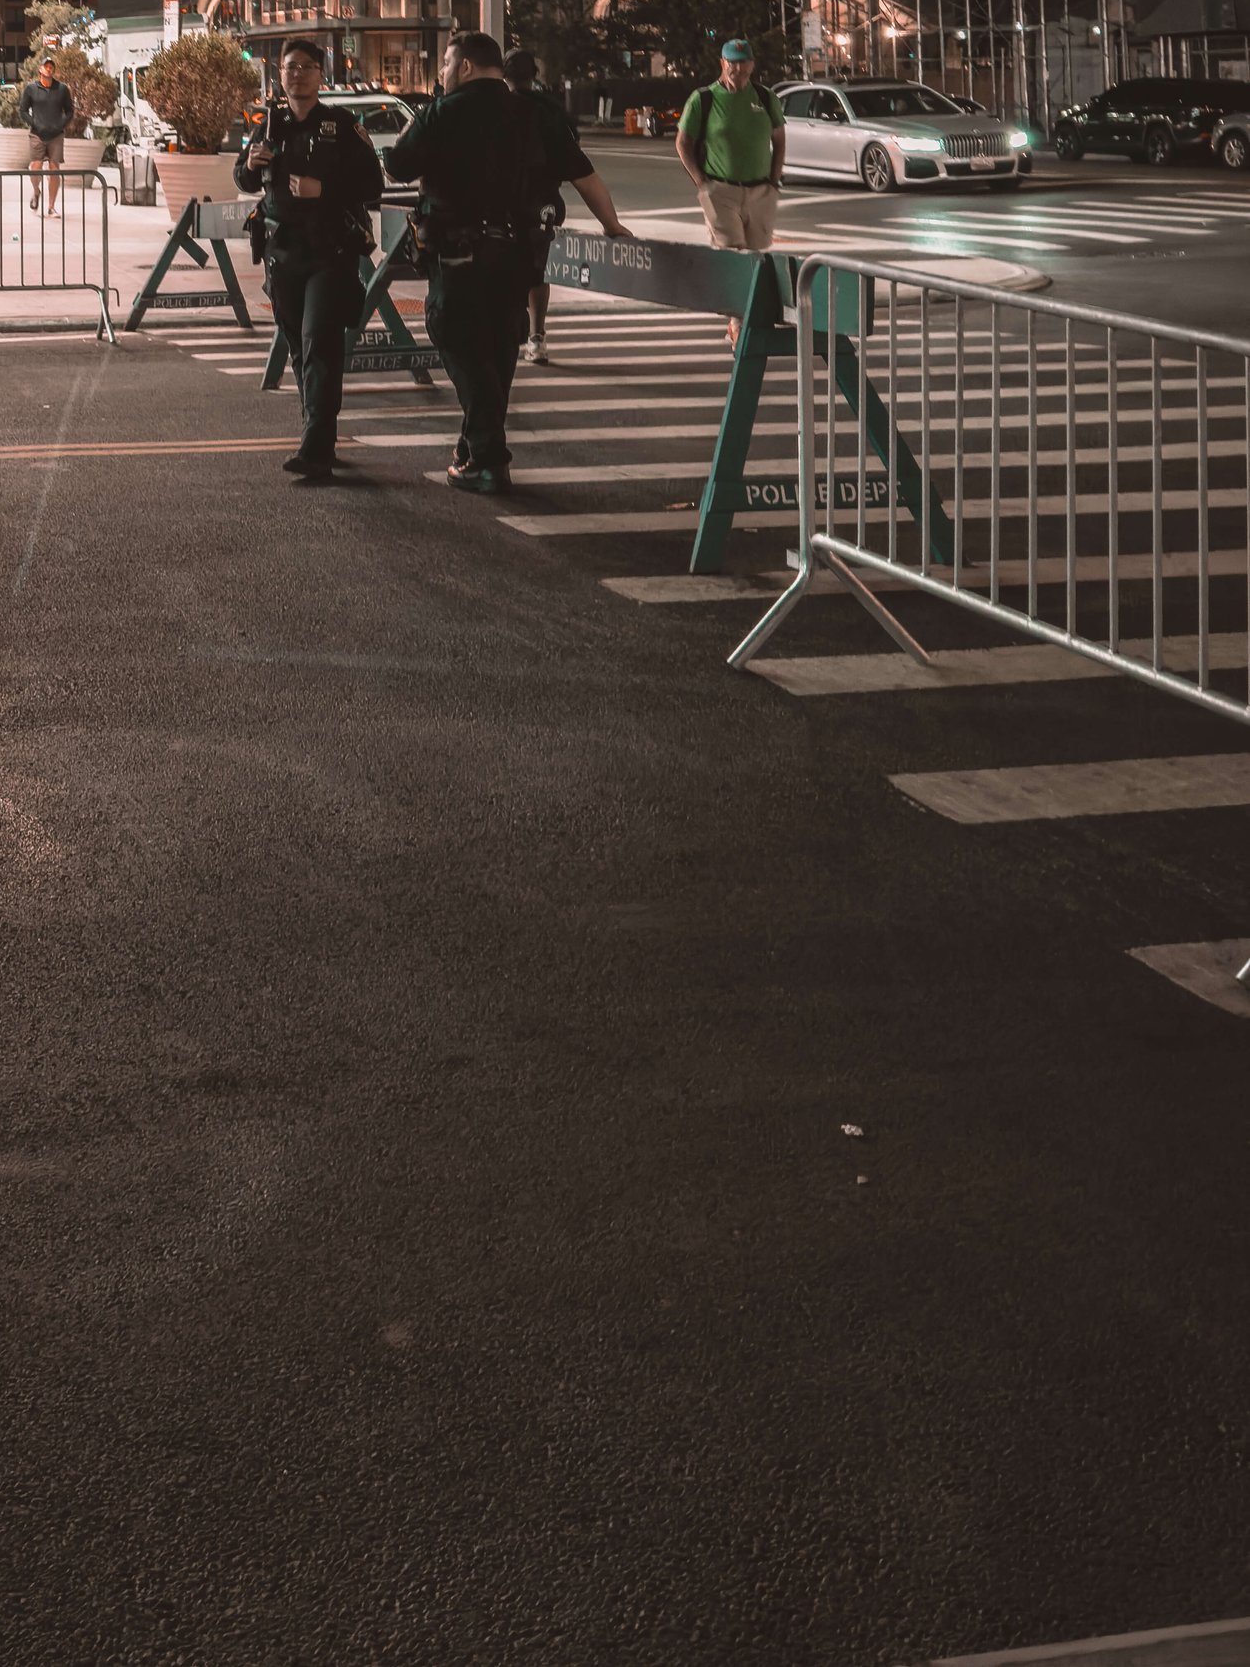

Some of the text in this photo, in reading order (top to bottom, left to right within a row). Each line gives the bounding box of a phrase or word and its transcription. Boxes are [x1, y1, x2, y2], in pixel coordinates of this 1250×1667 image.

[566, 237, 652, 270] DO NOT CROSS
[545, 262, 580, 280] NYPD
[153, 296, 192, 309] POLICE
[350, 354, 440, 370] POLICE DEP
[746, 484, 828, 505] POLIE
